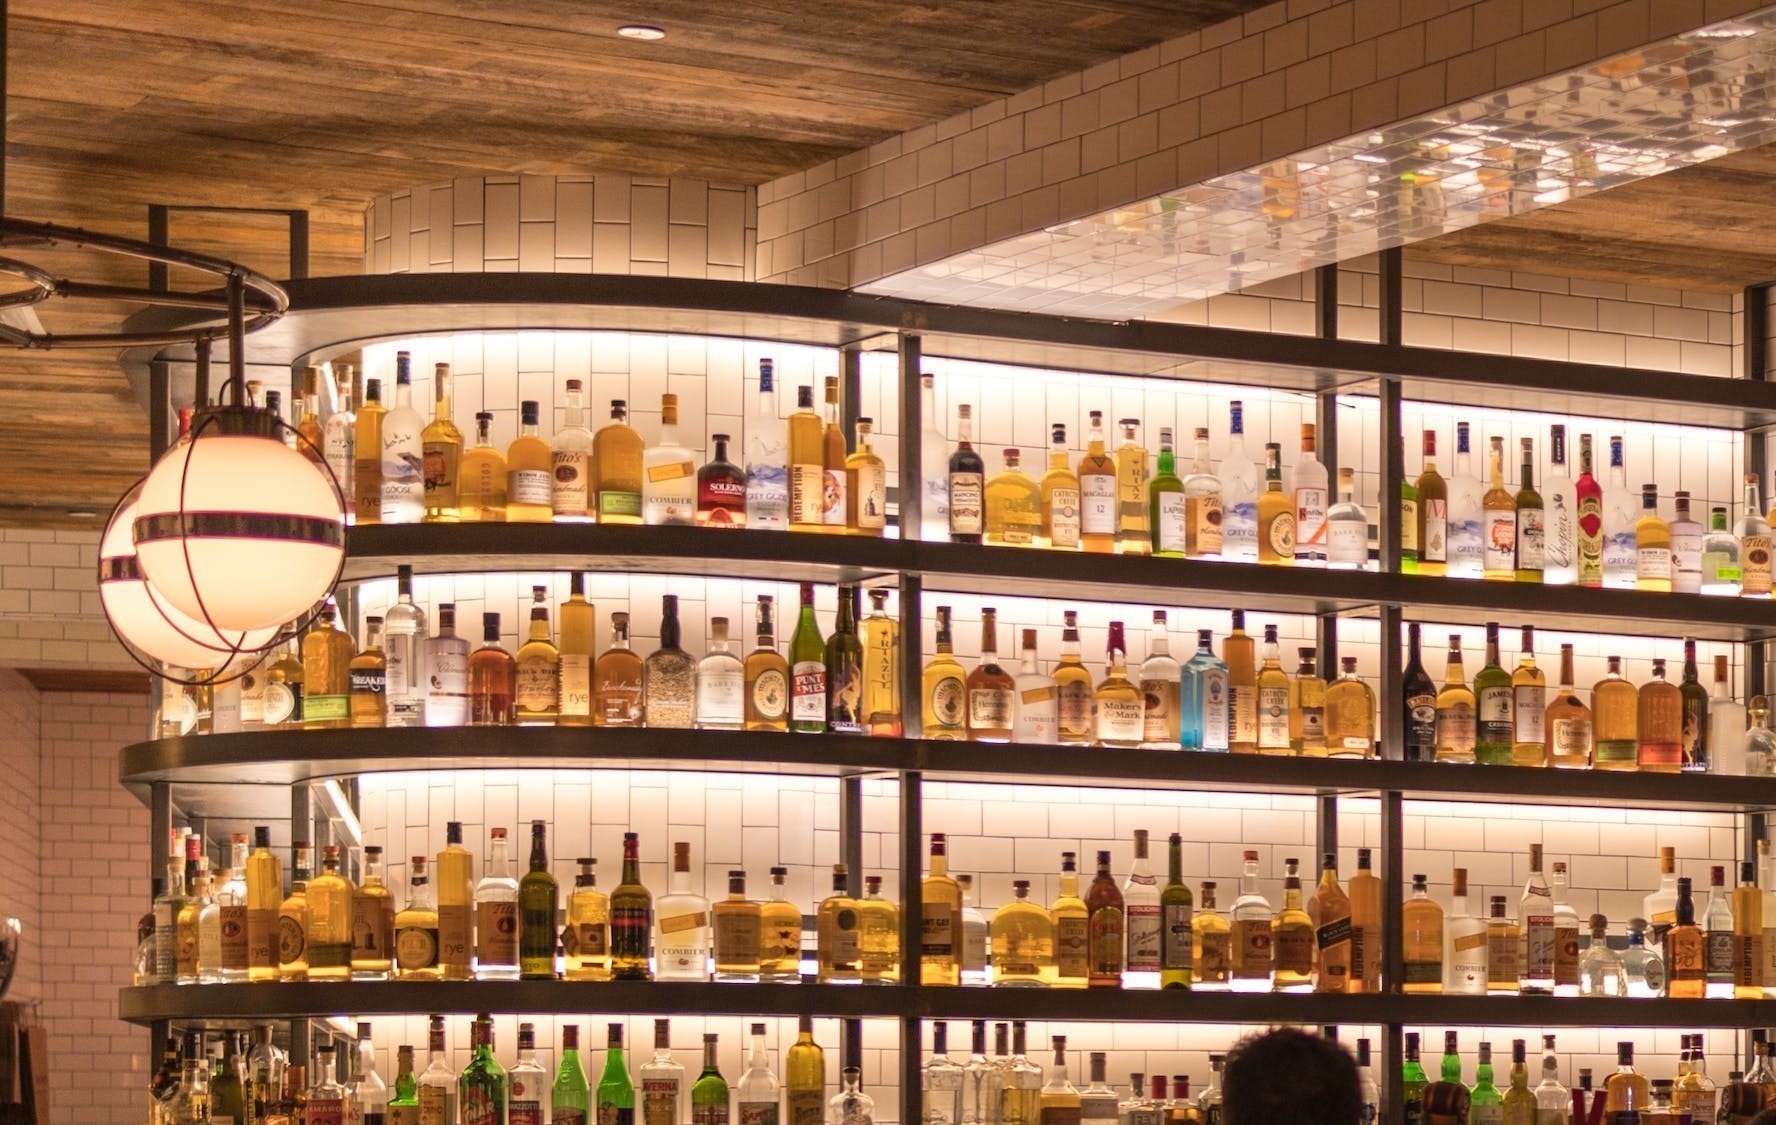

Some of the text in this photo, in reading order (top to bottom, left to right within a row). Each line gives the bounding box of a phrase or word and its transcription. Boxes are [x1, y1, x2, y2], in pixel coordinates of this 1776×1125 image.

[1096, 505, 1106, 514] 12
[795, 674, 822, 686] PUNT
[802, 684, 826, 693] MES
[568, 692, 589, 704] rye
[1115, 711, 1141, 720] Mark
[444, 942, 465, 955] rye
[662, 947, 707, 956] COMBIER
